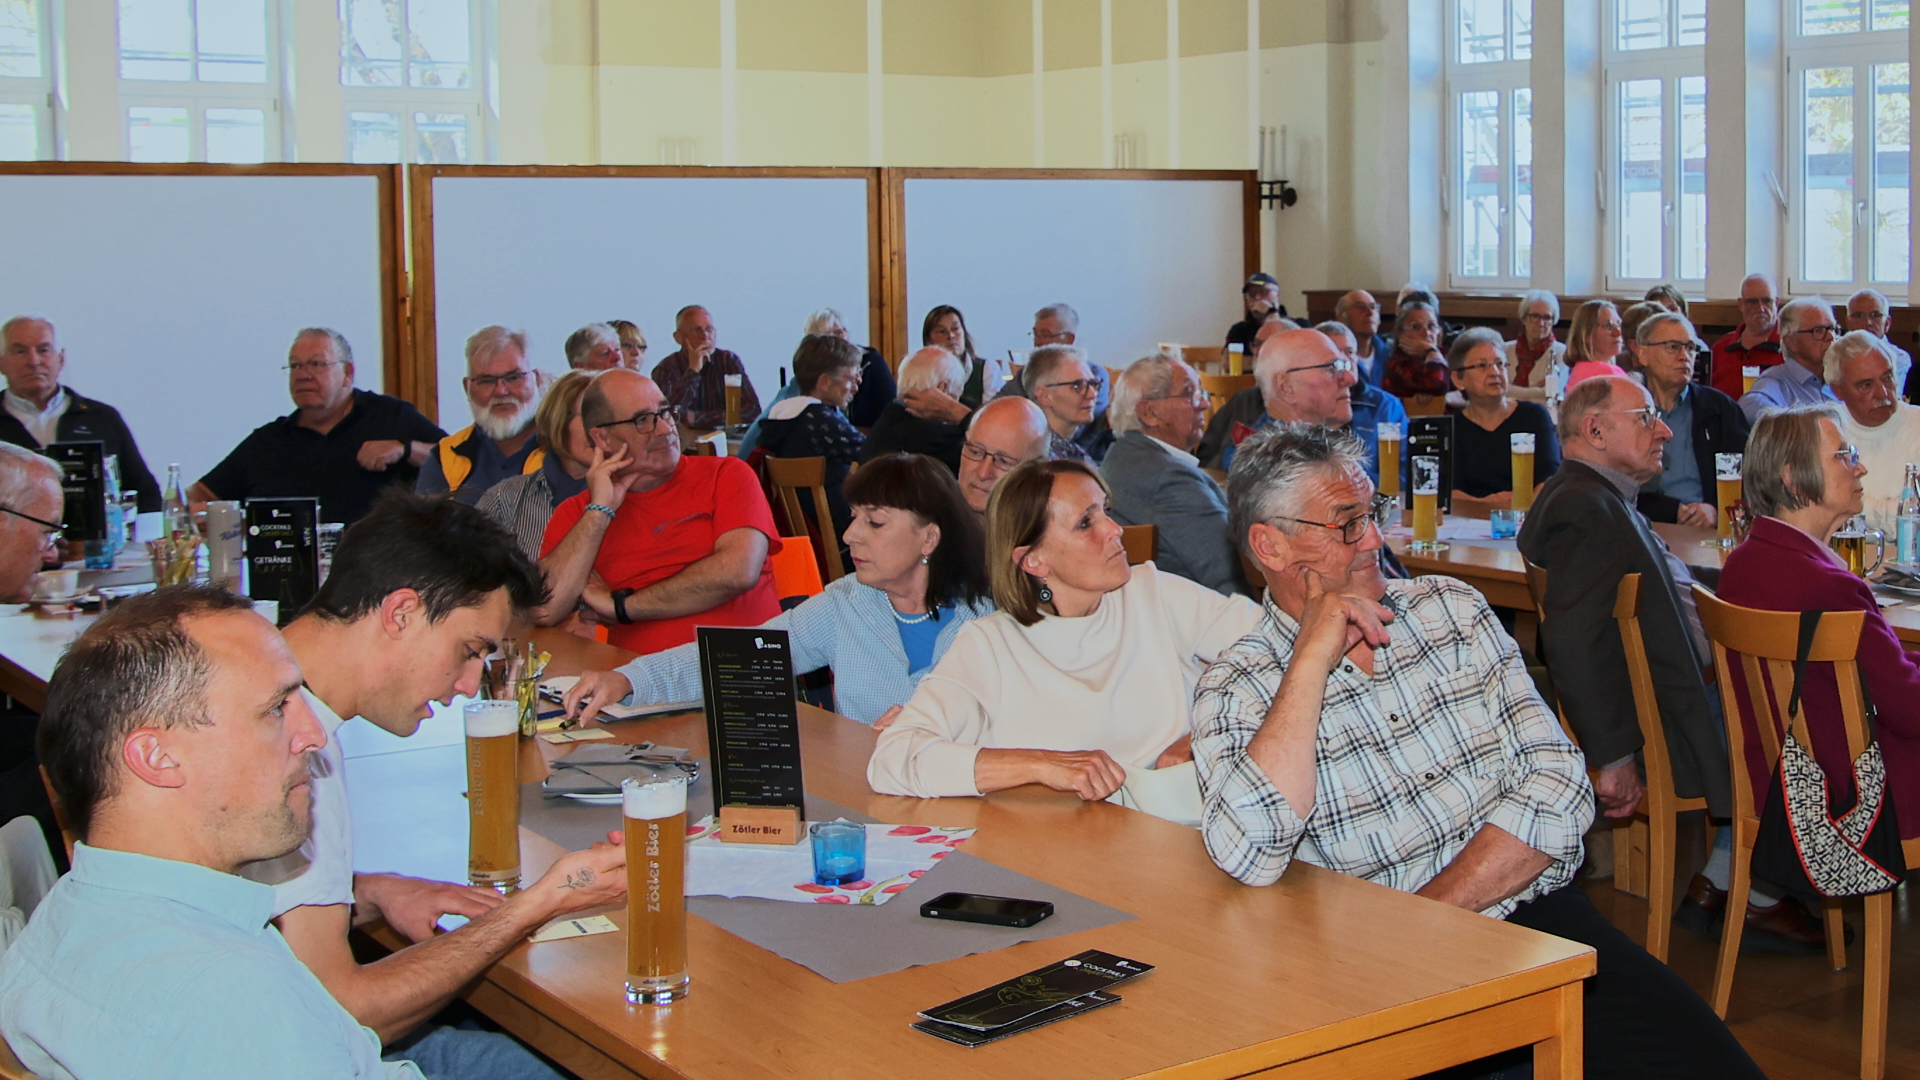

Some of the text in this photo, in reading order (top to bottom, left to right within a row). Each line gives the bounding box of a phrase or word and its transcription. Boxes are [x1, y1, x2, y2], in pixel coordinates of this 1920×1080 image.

[254, 555, 293, 564] GETRÄNKE
[732, 825, 782, 835] Zötler Bier
[645, 823, 661, 913] Zötler Bier
[1083, 963, 1127, 978] COCKTAILS
